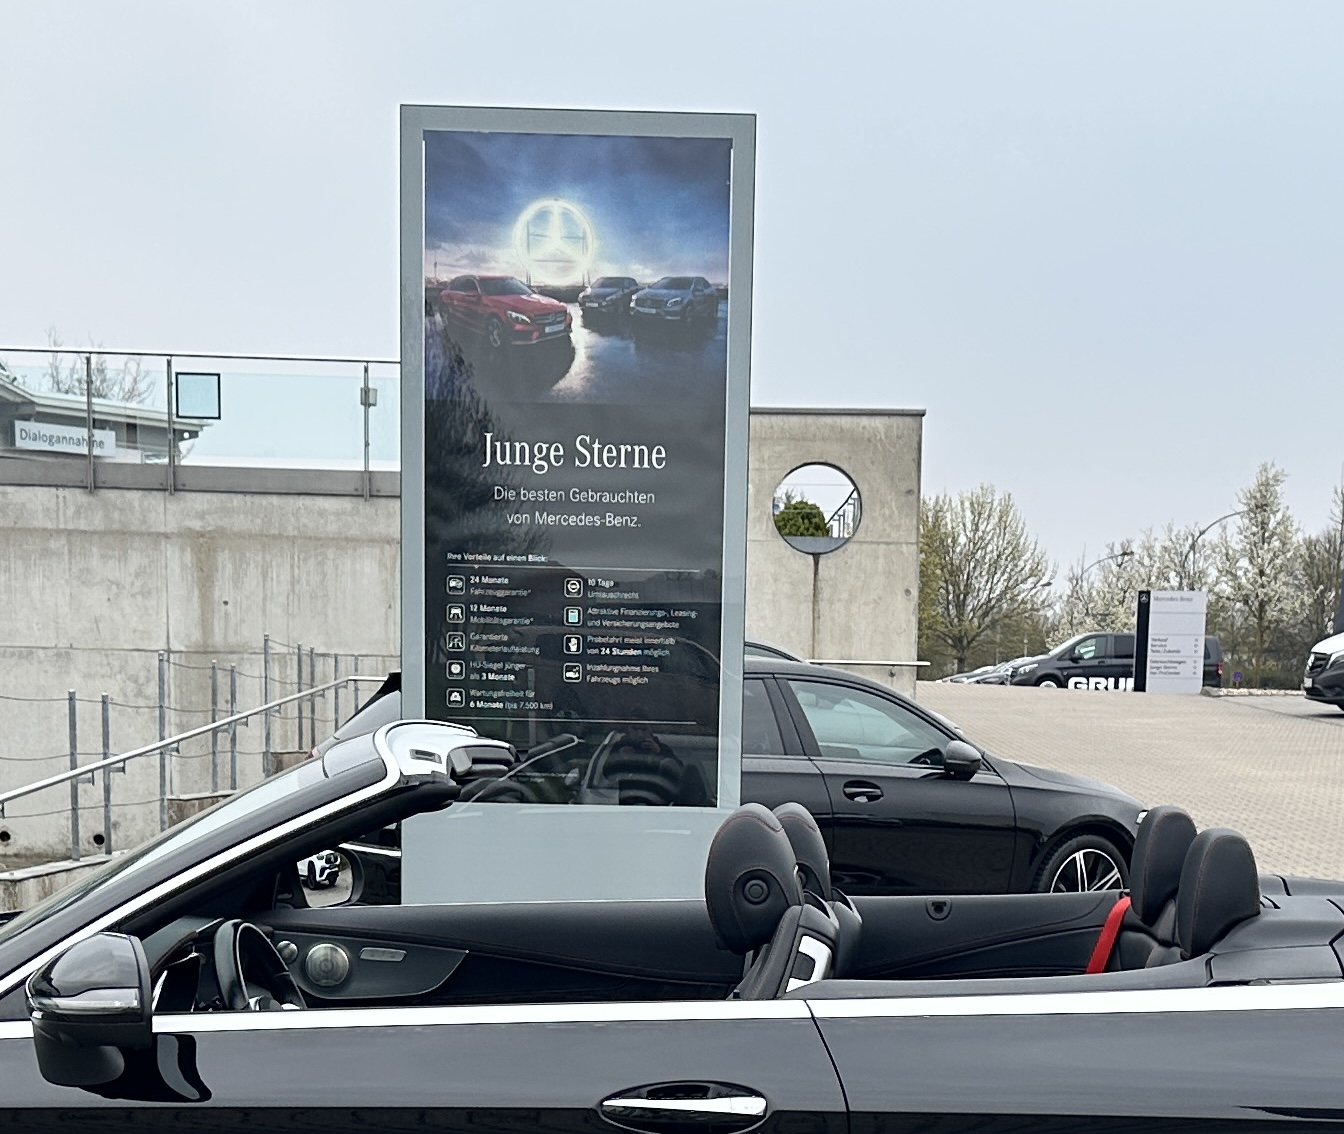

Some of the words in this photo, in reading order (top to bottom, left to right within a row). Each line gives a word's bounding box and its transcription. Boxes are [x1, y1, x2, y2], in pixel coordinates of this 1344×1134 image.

[482, 432, 564, 475] Junge
[575, 434, 666, 469] Sterne
[494, 486, 516, 500] Die
[520, 486, 565, 502] besten
[569, 488, 655, 504] Gebrauchten
[507, 512, 530, 524] von
[535, 511, 642, 528] Mercedes-Benz.
[493, 553, 505, 561] auf
[470, 576, 479, 584] 24
[597, 579, 614, 588] Tage
[600, 647, 611, 655] 24
[481, 673, 487, 681] 3
[488, 673, 516, 681] Monate
[476, 701, 504, 709] Monate
